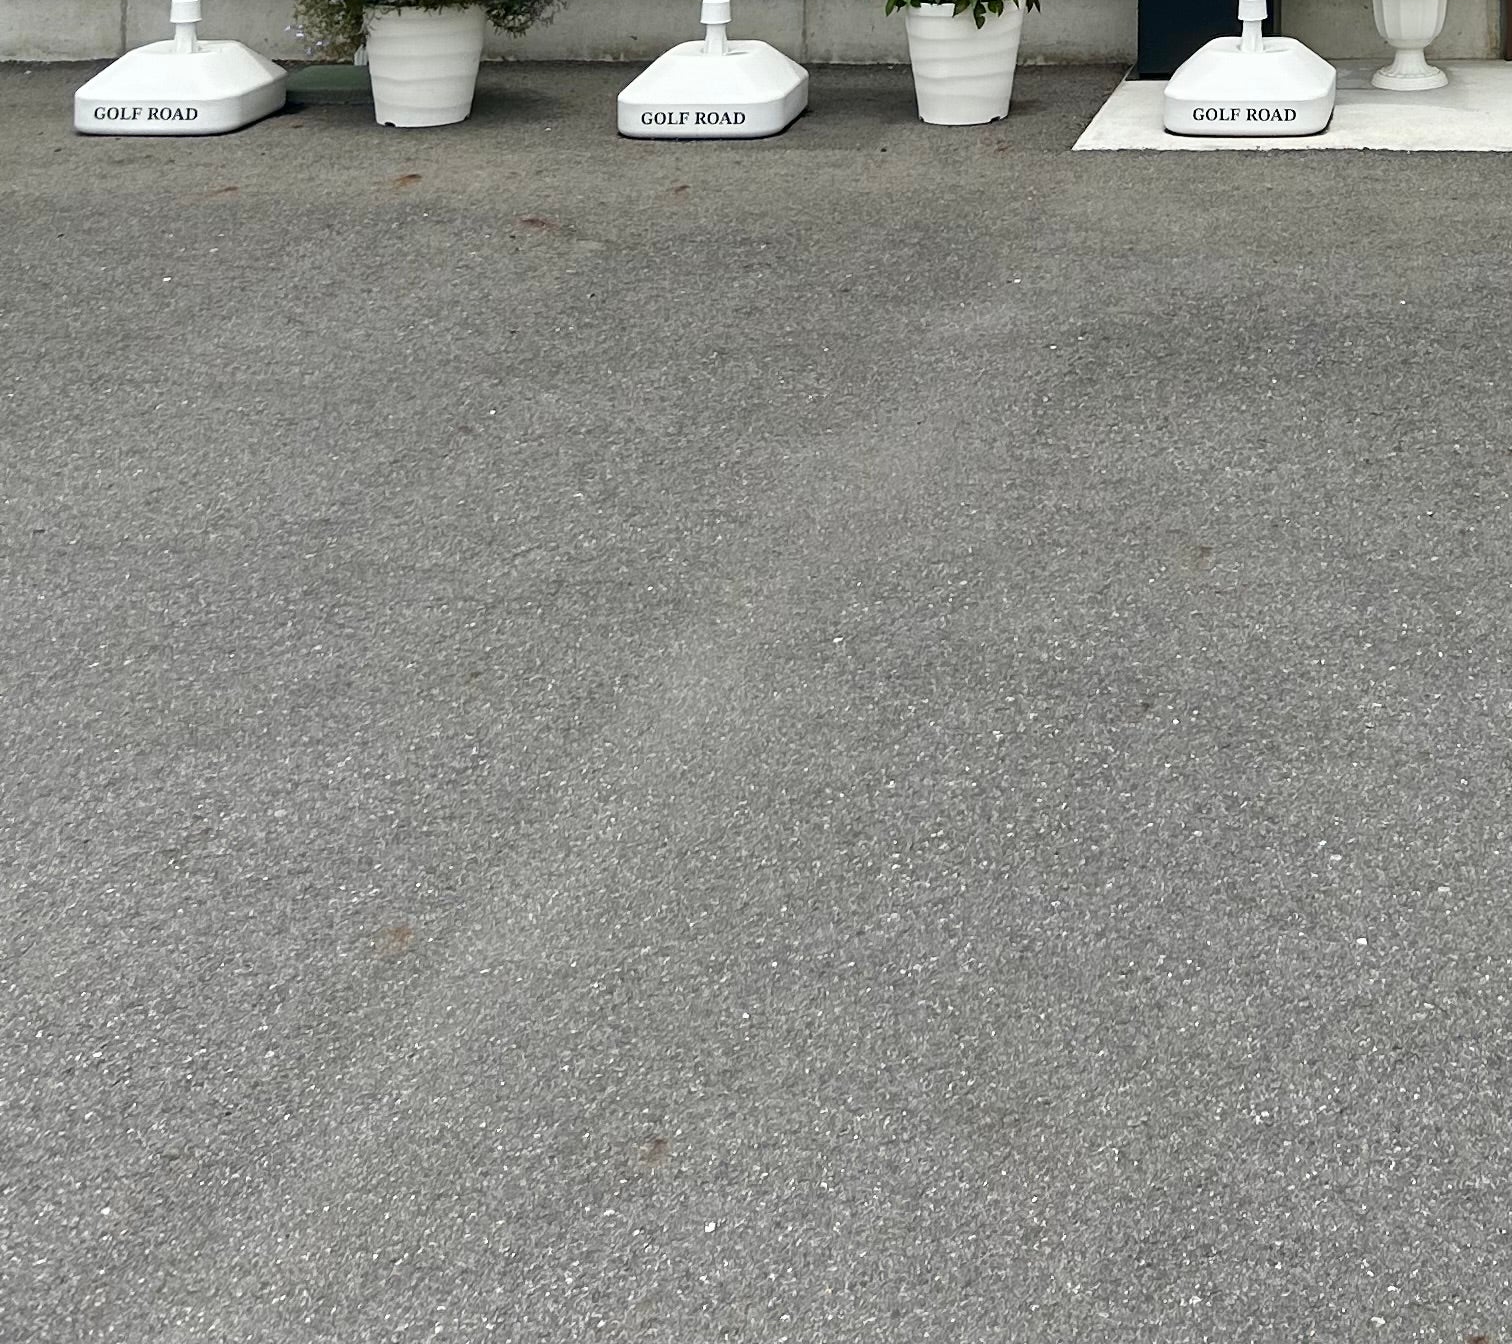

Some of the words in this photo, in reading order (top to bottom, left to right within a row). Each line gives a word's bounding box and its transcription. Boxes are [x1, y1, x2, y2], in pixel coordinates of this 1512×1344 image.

[94, 106, 142, 120] GOLF
[147, 107, 198, 120] ROAD
[641, 111, 690, 125] GOLF
[695, 111, 746, 125] ROAD
[1192, 107, 1240, 121] GOLF
[1246, 108, 1297, 121] ROAD
